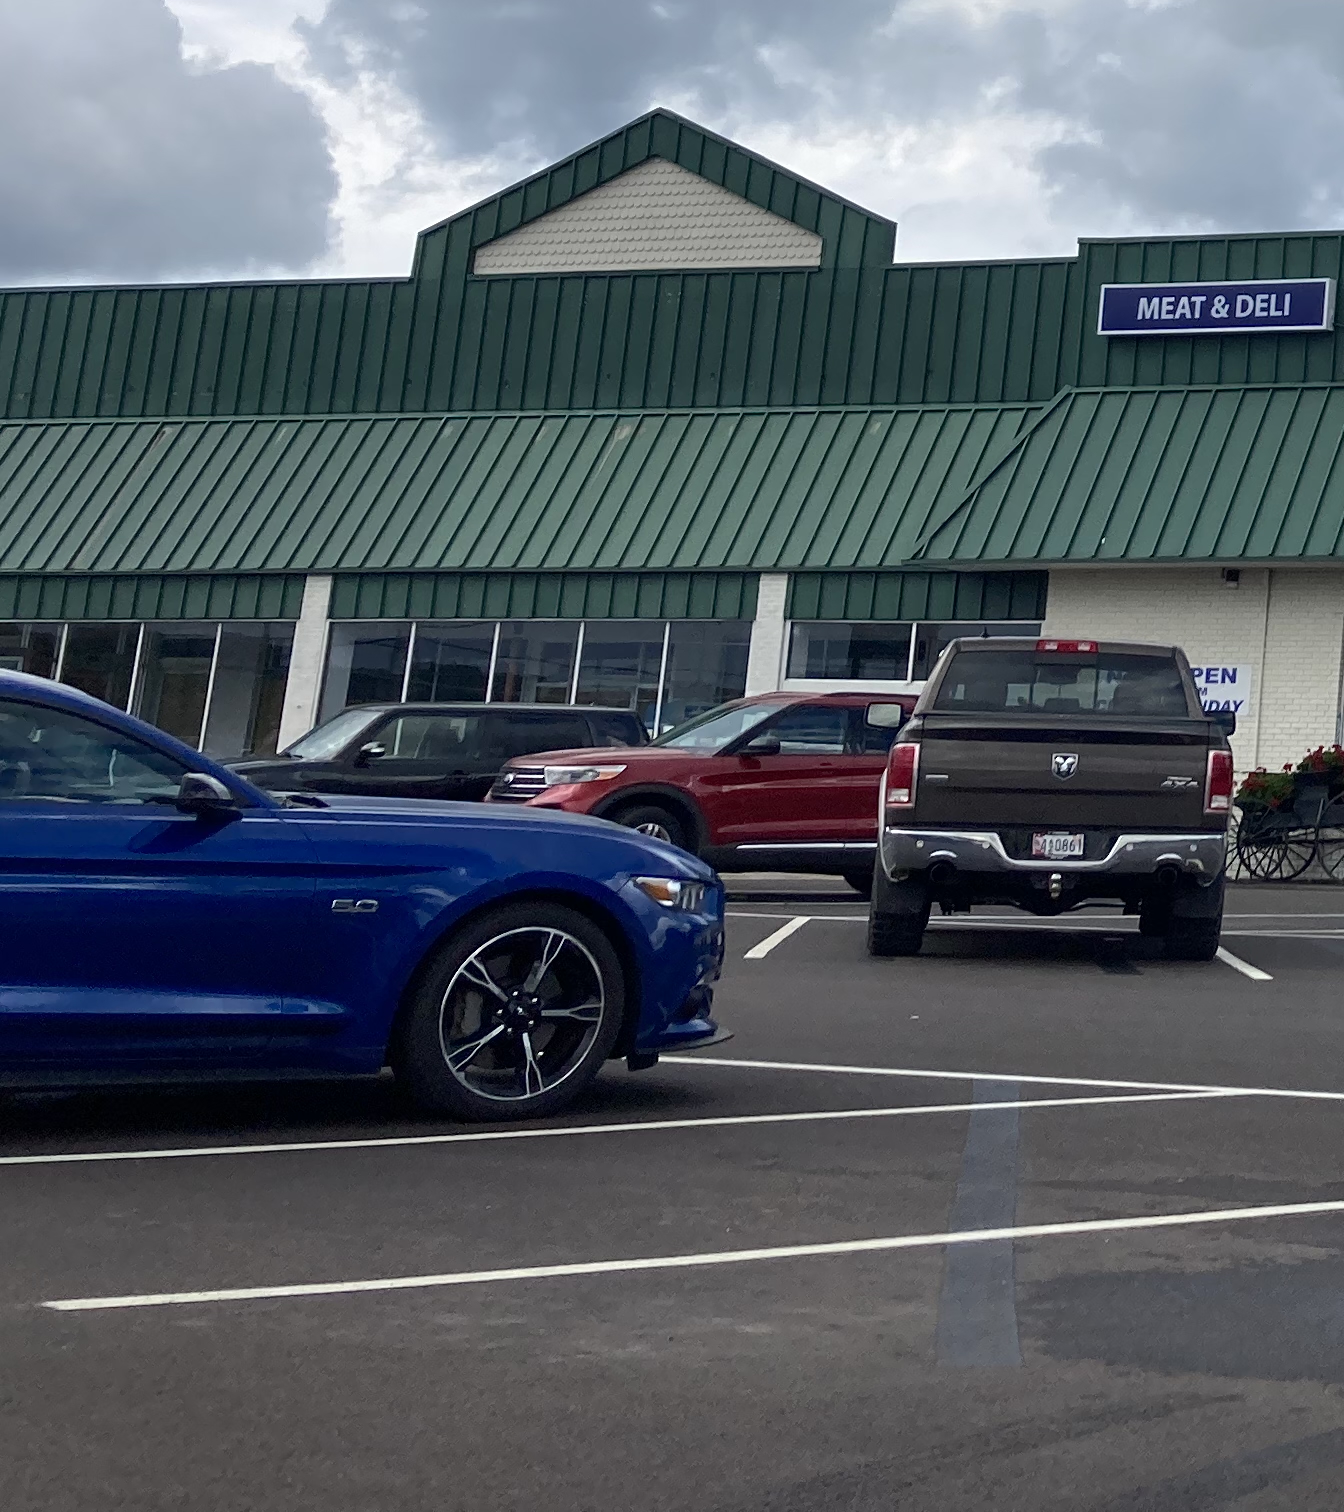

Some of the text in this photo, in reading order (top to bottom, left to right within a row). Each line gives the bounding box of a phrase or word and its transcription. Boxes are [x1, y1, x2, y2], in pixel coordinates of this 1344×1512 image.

[1137, 292, 1291, 320] MEAT & DELI
[1190, 667, 1238, 684] PEN
